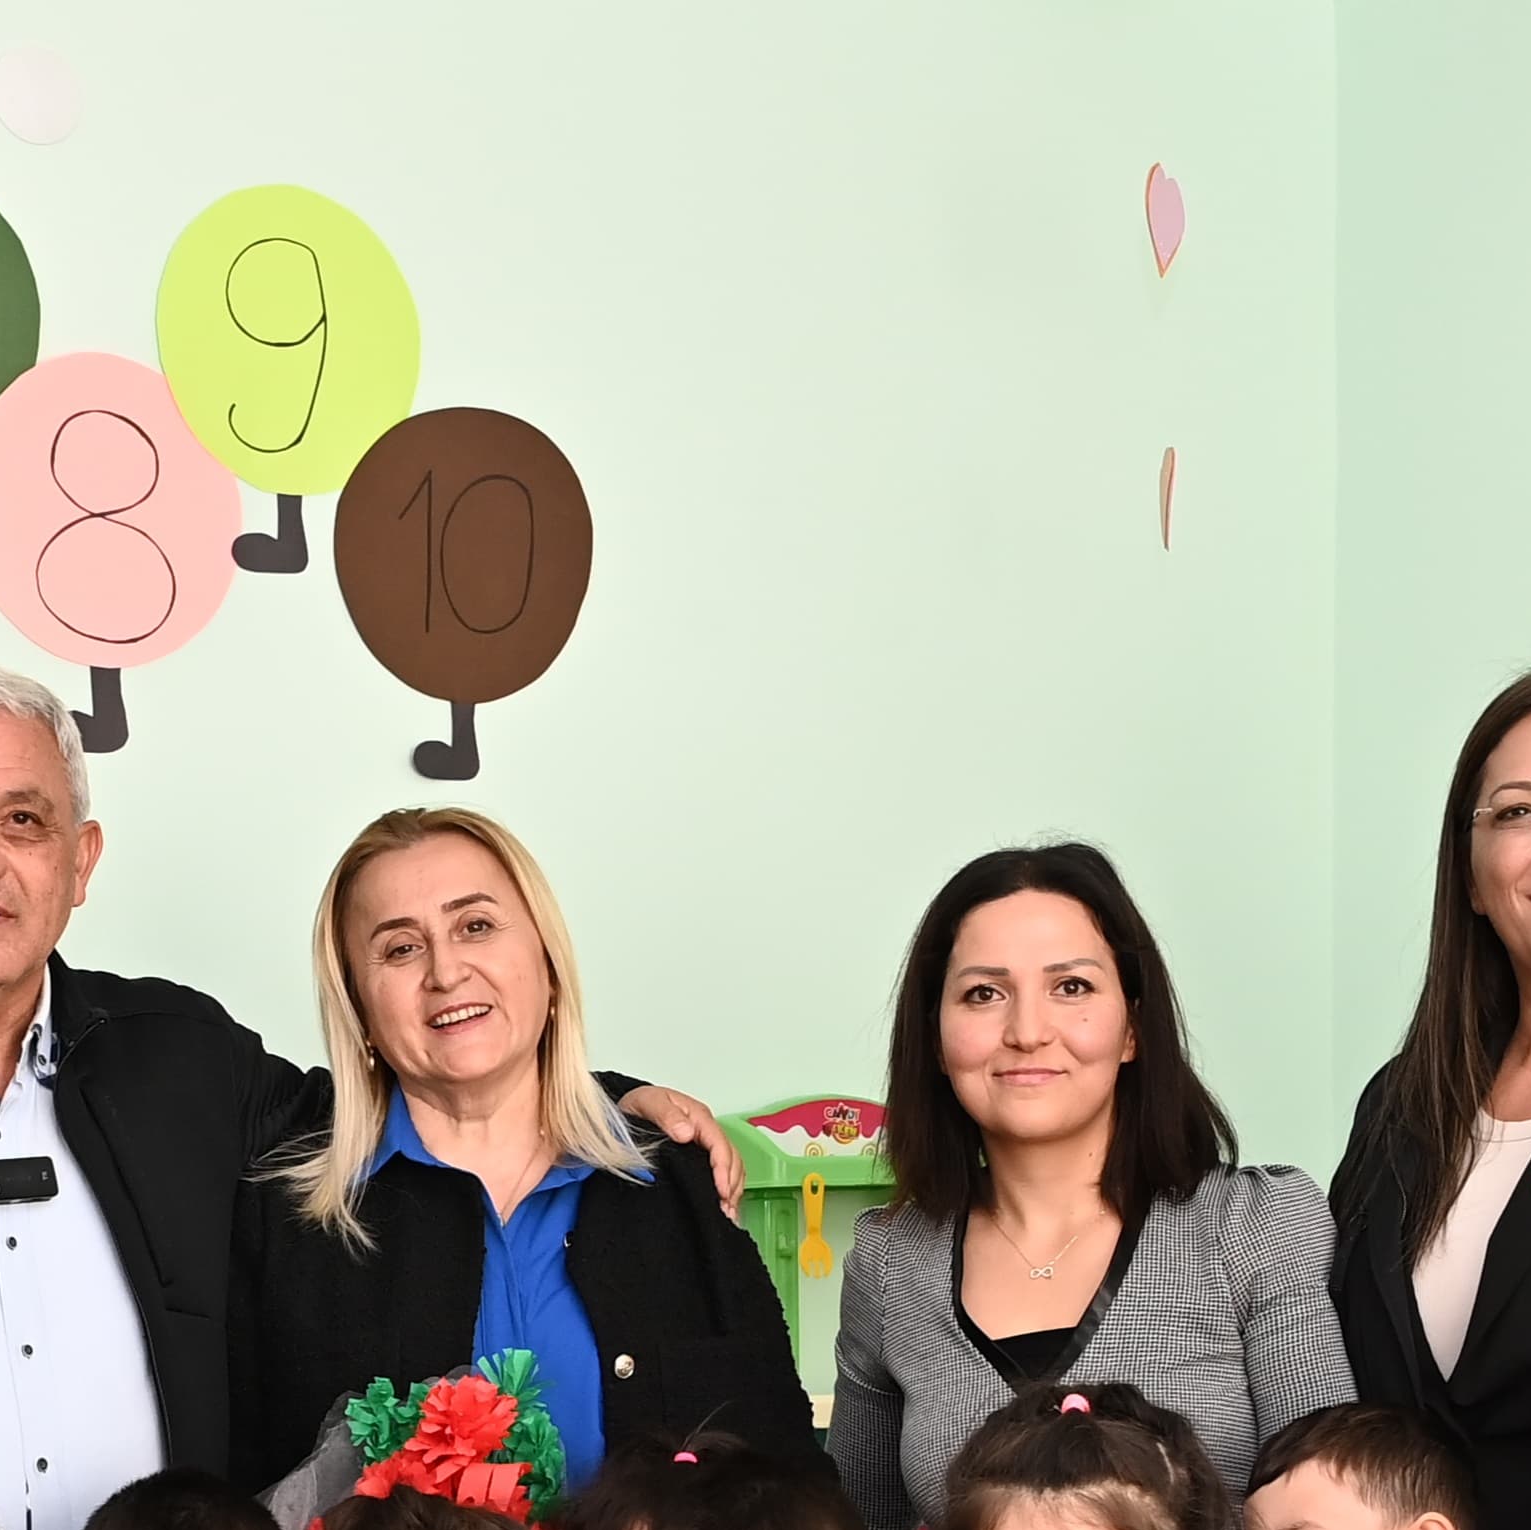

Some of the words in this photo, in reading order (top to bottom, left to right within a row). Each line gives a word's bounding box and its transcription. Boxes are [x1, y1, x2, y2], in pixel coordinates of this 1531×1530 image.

[225, 236, 328, 453] 9
[34, 408, 176, 644] 8
[397, 469, 535, 634] 10
